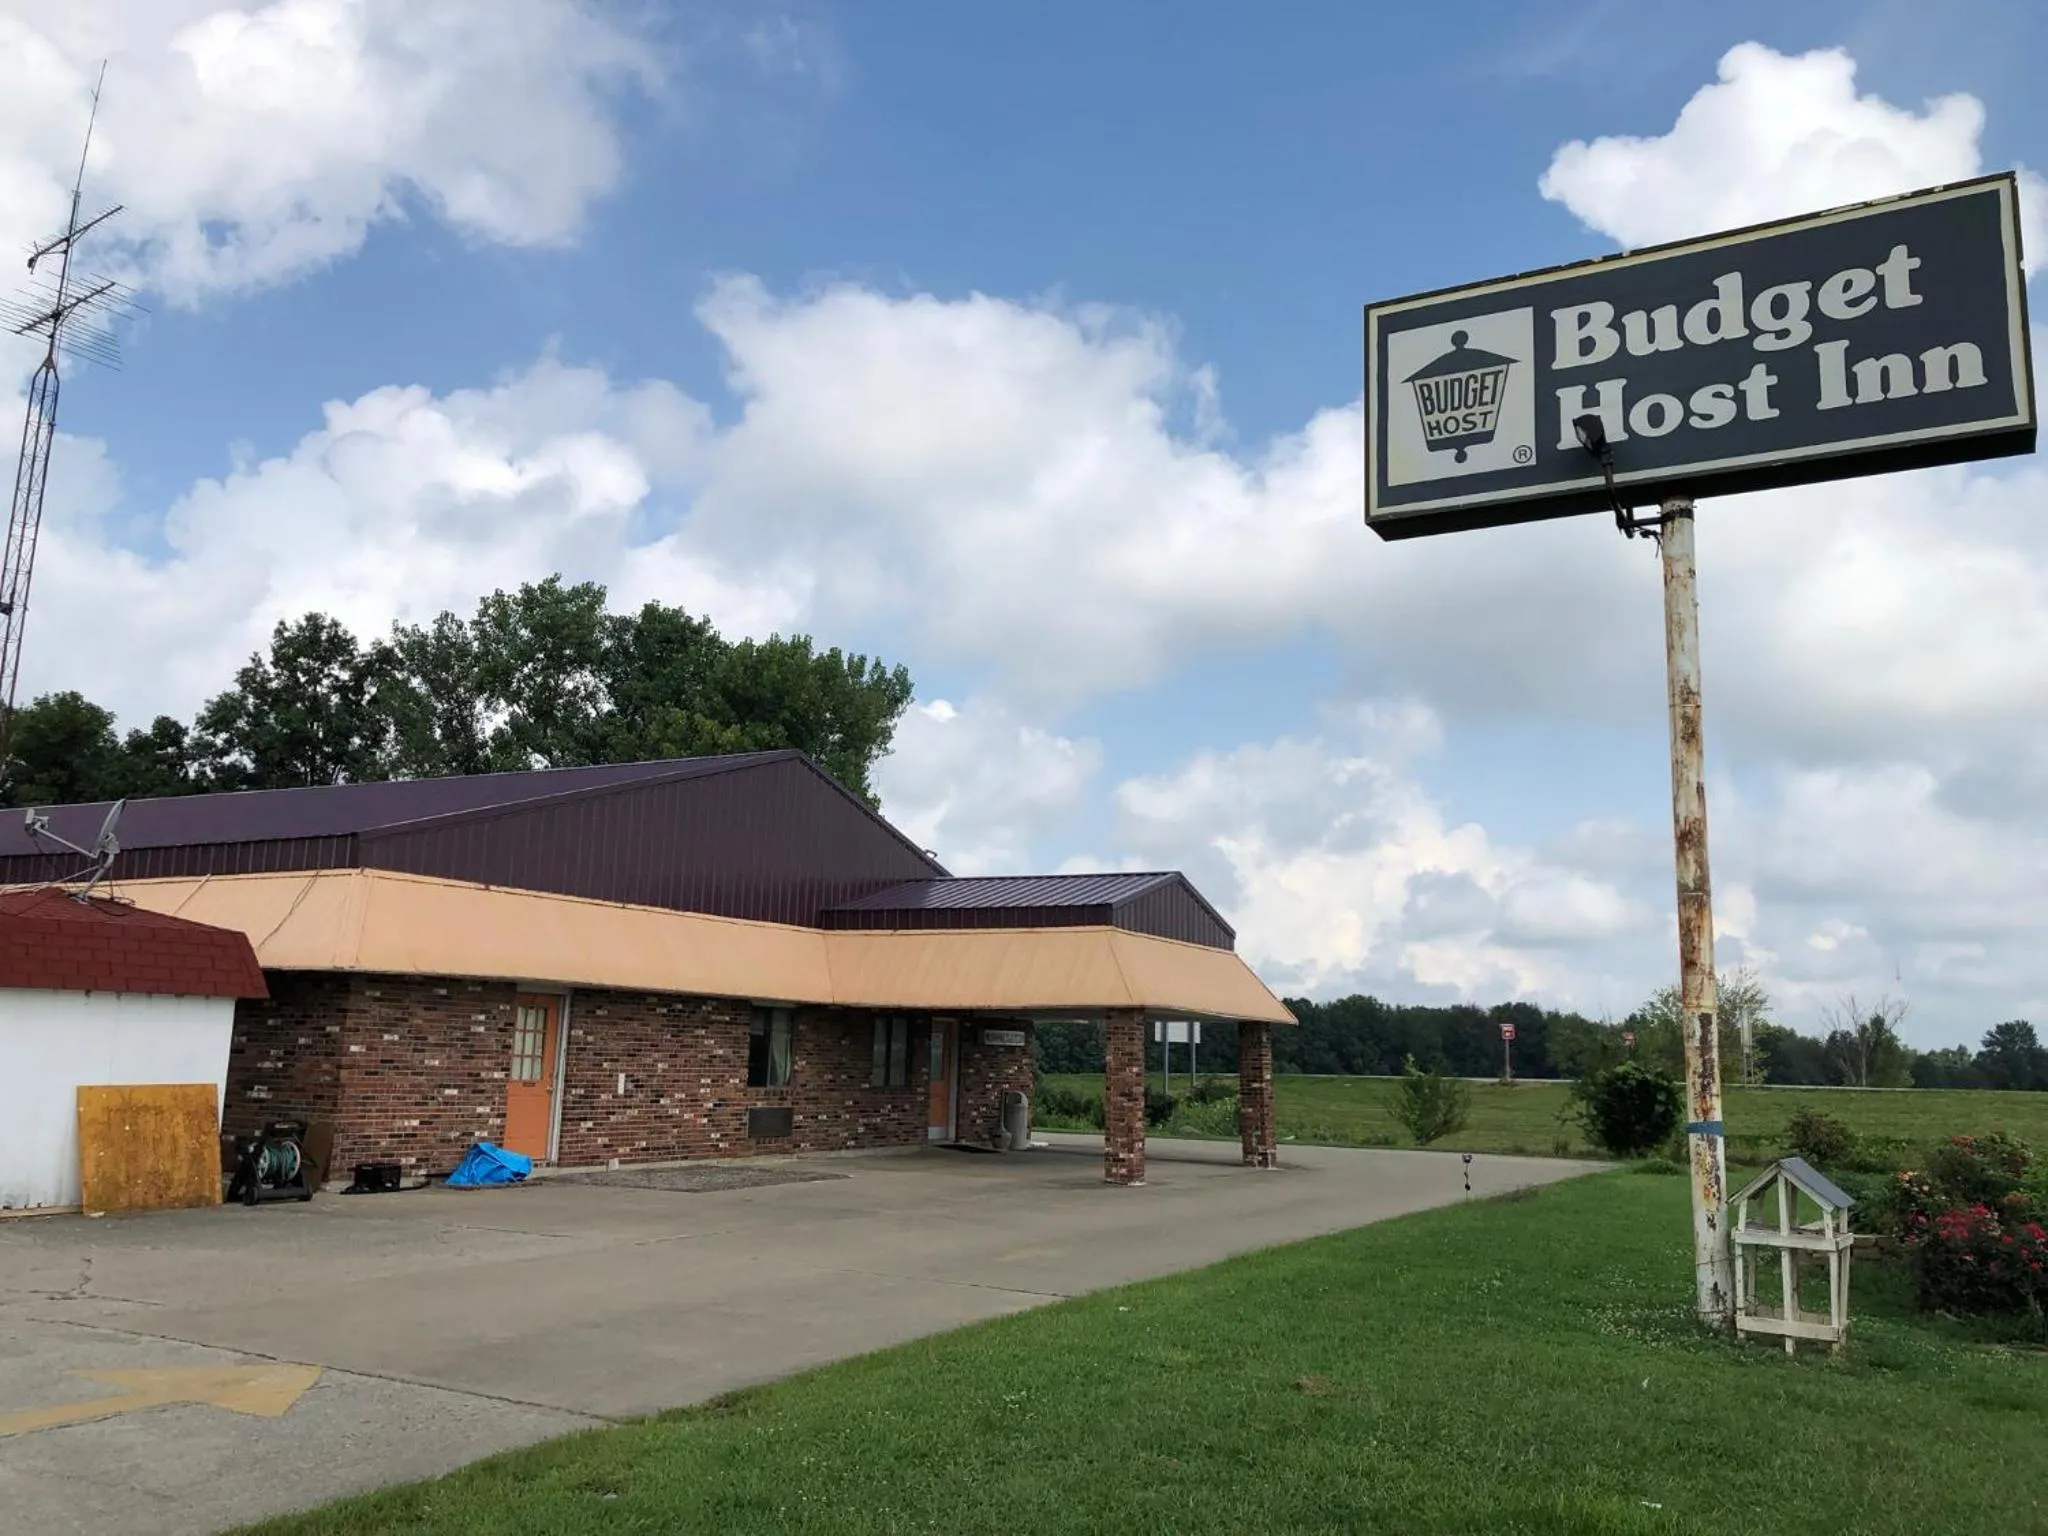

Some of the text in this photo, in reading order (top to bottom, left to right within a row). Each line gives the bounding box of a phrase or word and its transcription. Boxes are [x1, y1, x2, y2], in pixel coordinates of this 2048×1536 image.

[1551, 245, 1924, 370] Budget
[1418, 369, 1504, 416] BUDGET
[1426, 410, 1494, 437] HOST
[1555, 338, 1989, 452] Host Inn
